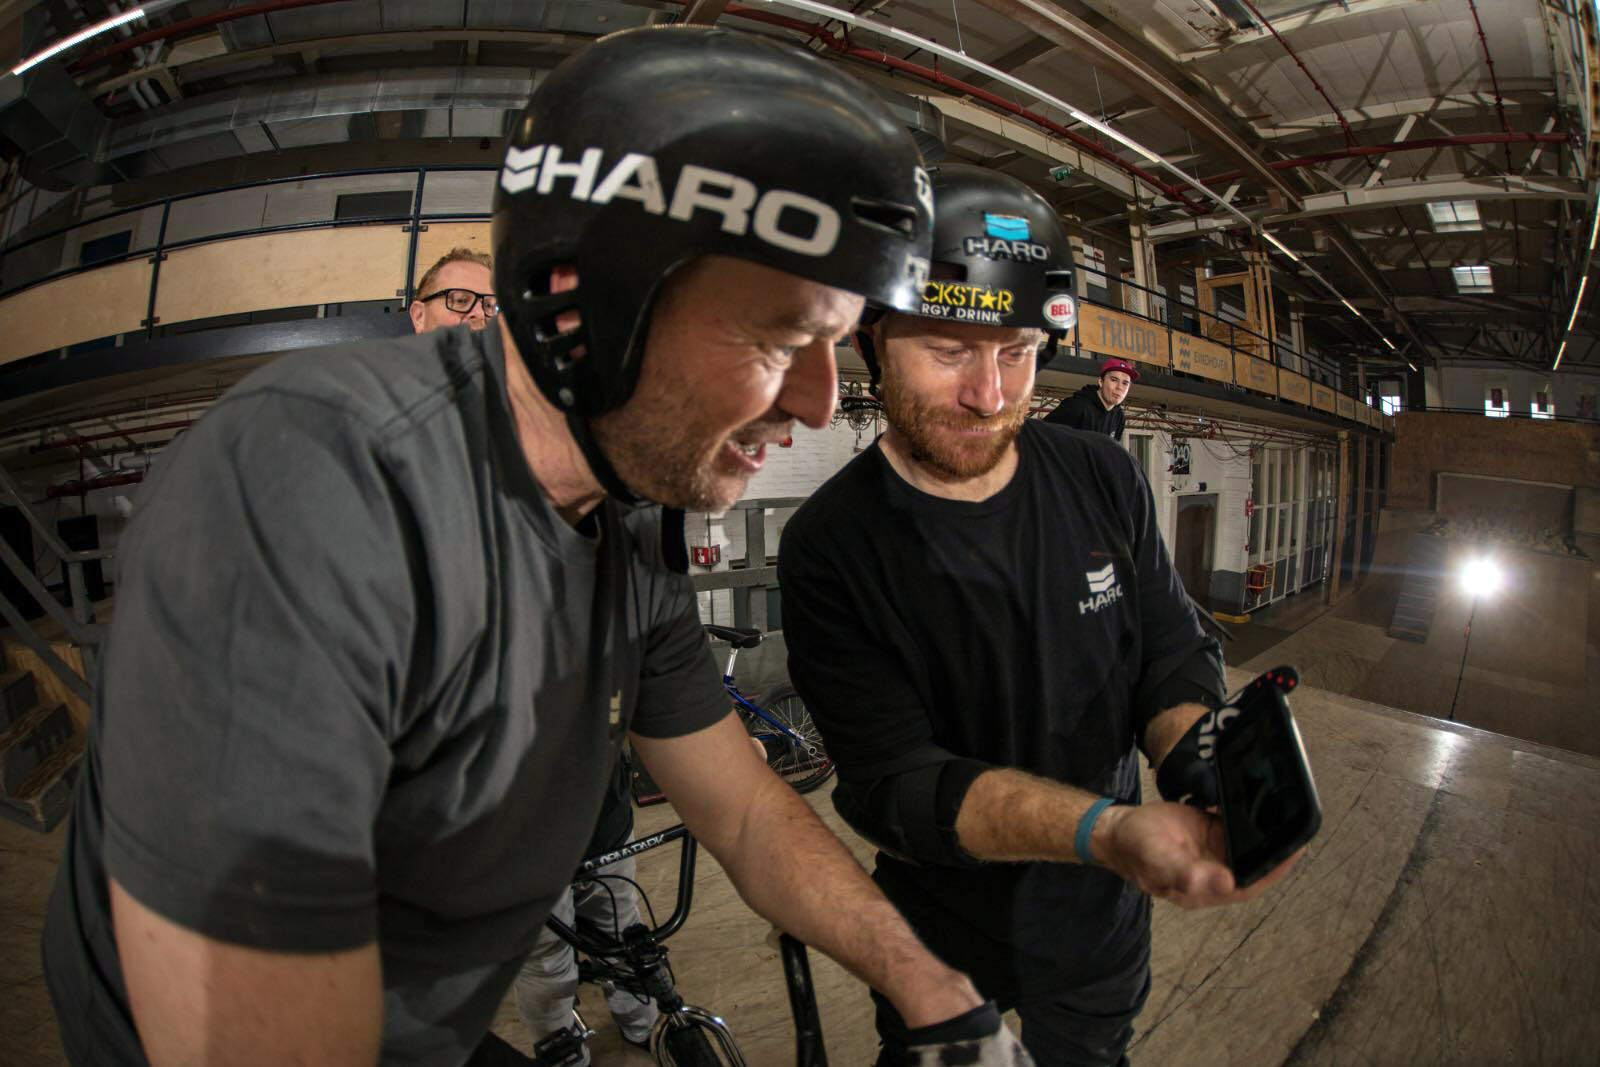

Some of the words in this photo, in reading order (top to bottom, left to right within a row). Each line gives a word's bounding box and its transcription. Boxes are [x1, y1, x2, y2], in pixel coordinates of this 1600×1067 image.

[536, 146, 842, 258] HARO
[967, 238, 1047, 259] HARO
[922, 281, 1014, 312] CKSTAR
[921, 303, 952, 318] RGY
[955, 307, 1001, 322] DRINK
[1050, 303, 1072, 317] BELL
